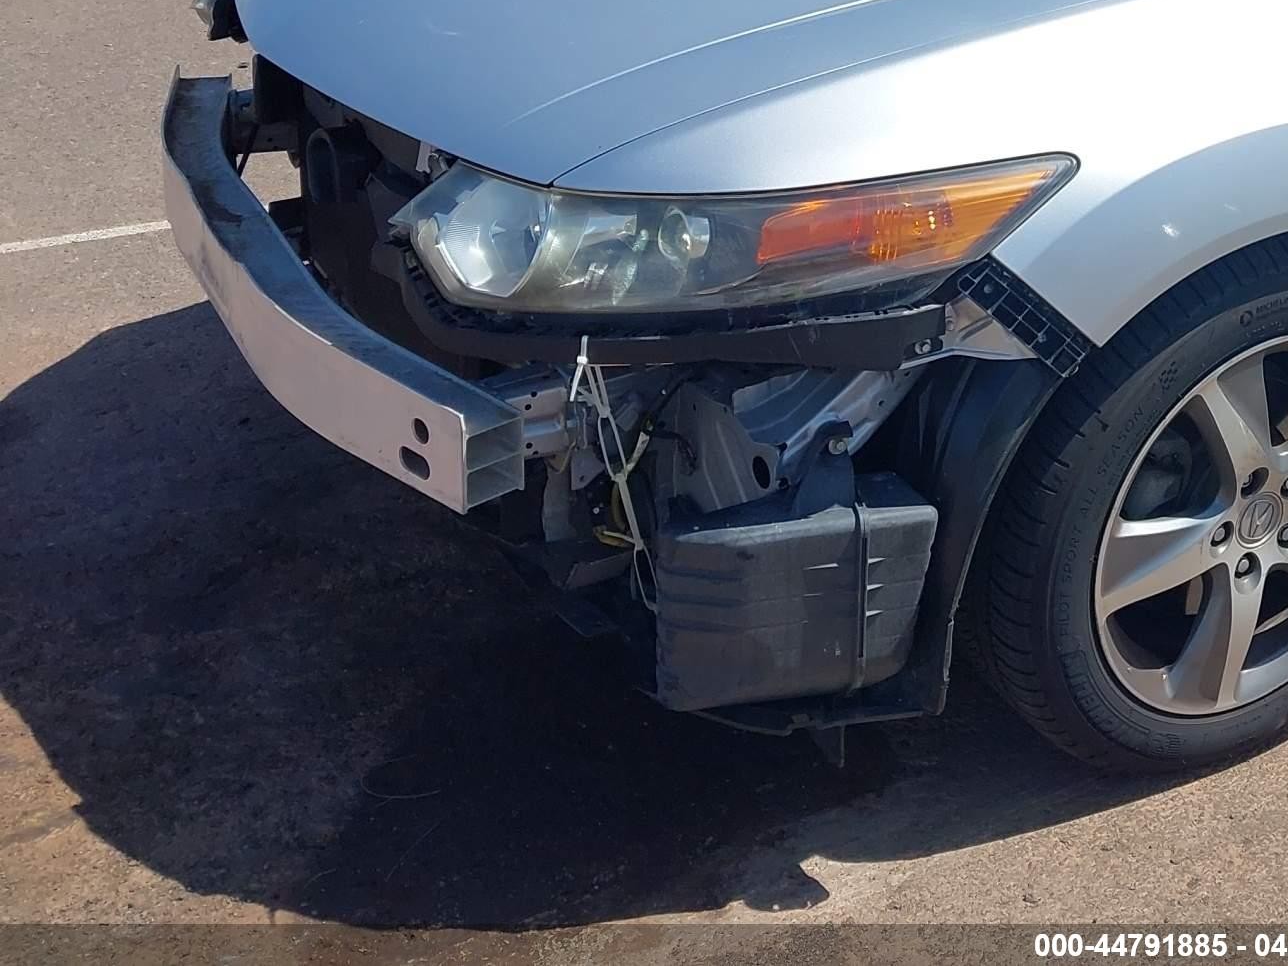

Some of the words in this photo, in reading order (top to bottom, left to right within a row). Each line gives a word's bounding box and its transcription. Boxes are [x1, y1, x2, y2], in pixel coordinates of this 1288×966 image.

[1097, 405, 1145, 476] SEASON
[1079, 487, 1097, 515] ALL
[1063, 527, 1082, 579] SPORT
[1057, 594, 1071, 636] PILOT
